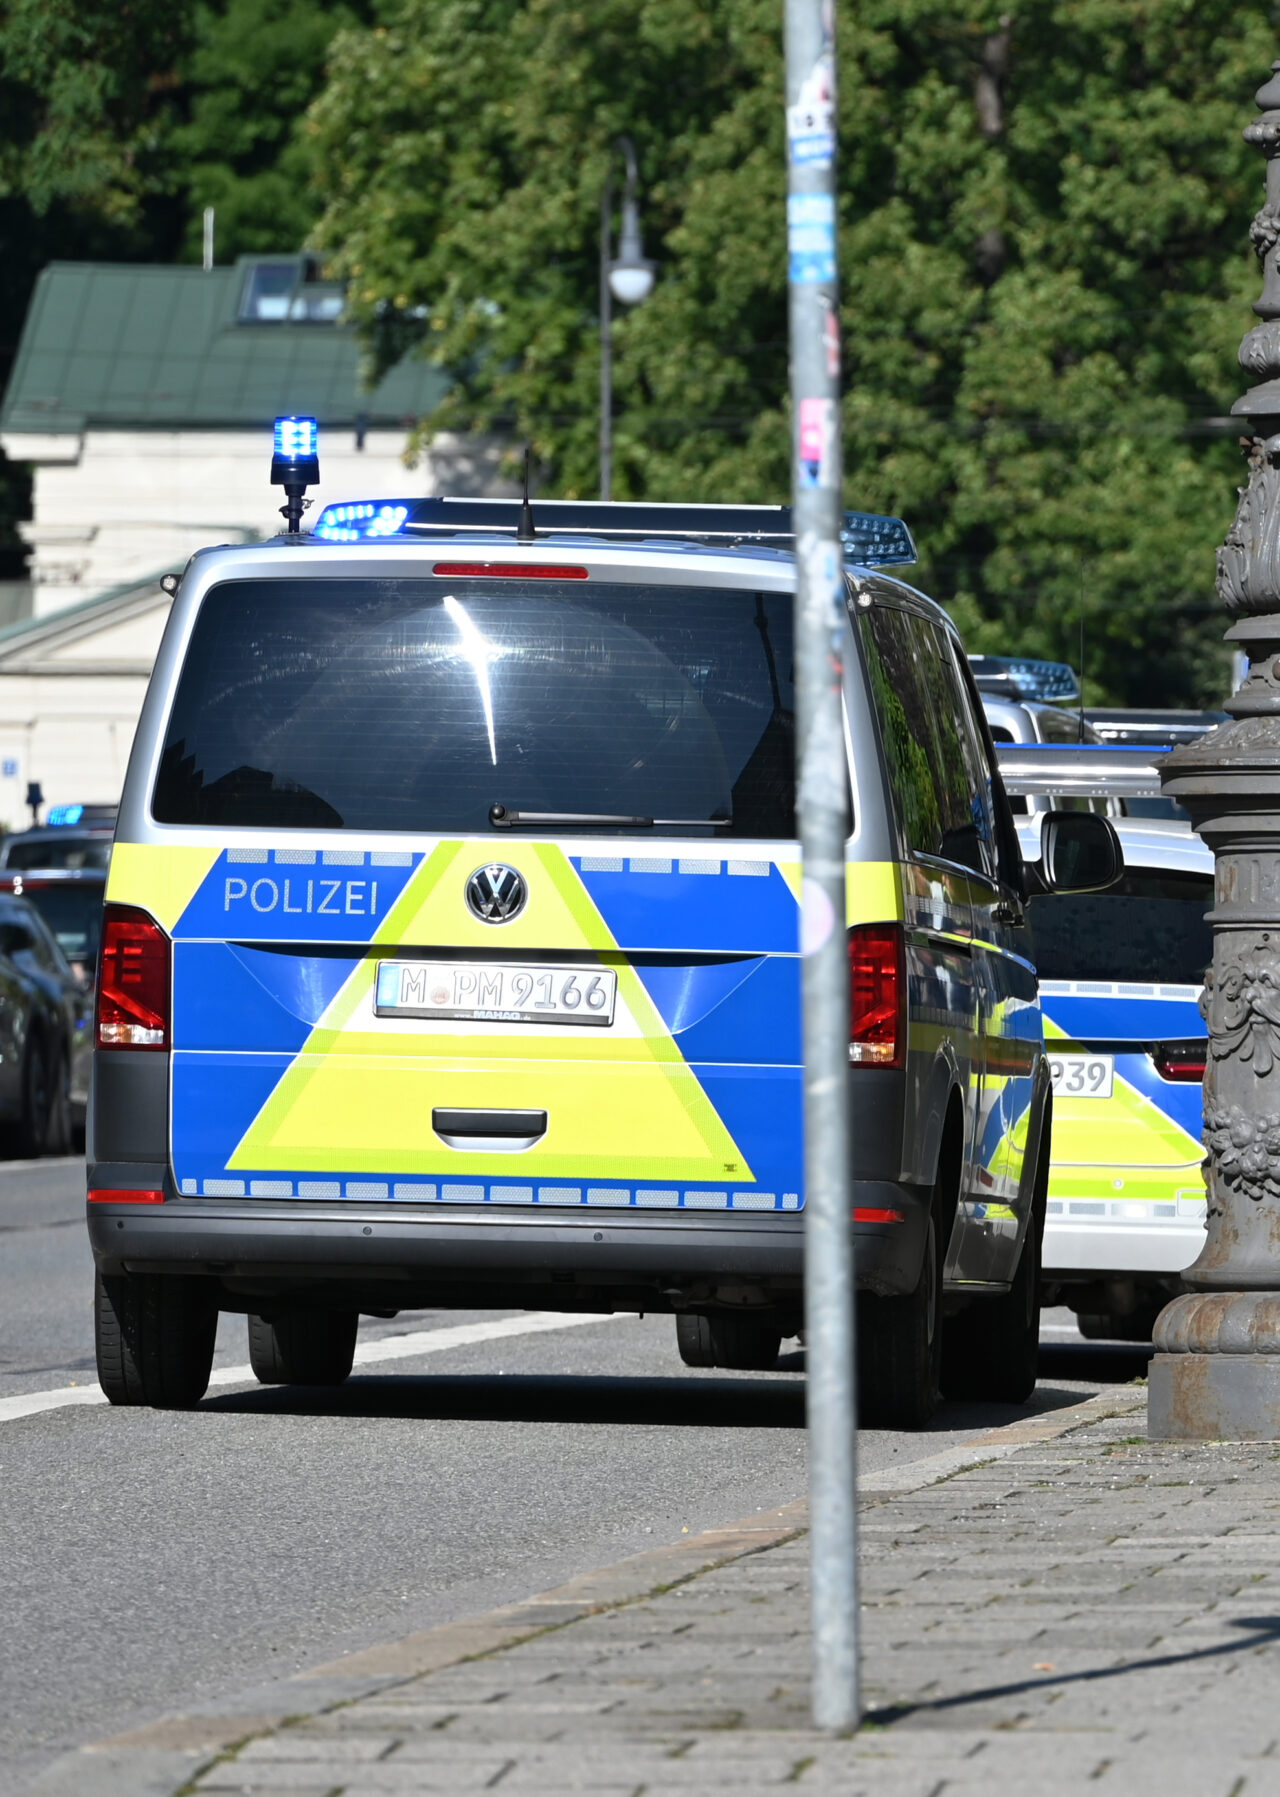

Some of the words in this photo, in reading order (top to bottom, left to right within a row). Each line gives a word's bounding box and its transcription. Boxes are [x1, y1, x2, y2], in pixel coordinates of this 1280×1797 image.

[224, 877, 378, 915] POLIZEI
[467, 863, 525, 921] VW
[400, 968, 427, 1003] M
[453, 970, 504, 1006] PM
[511, 973, 607, 1010] 9166
